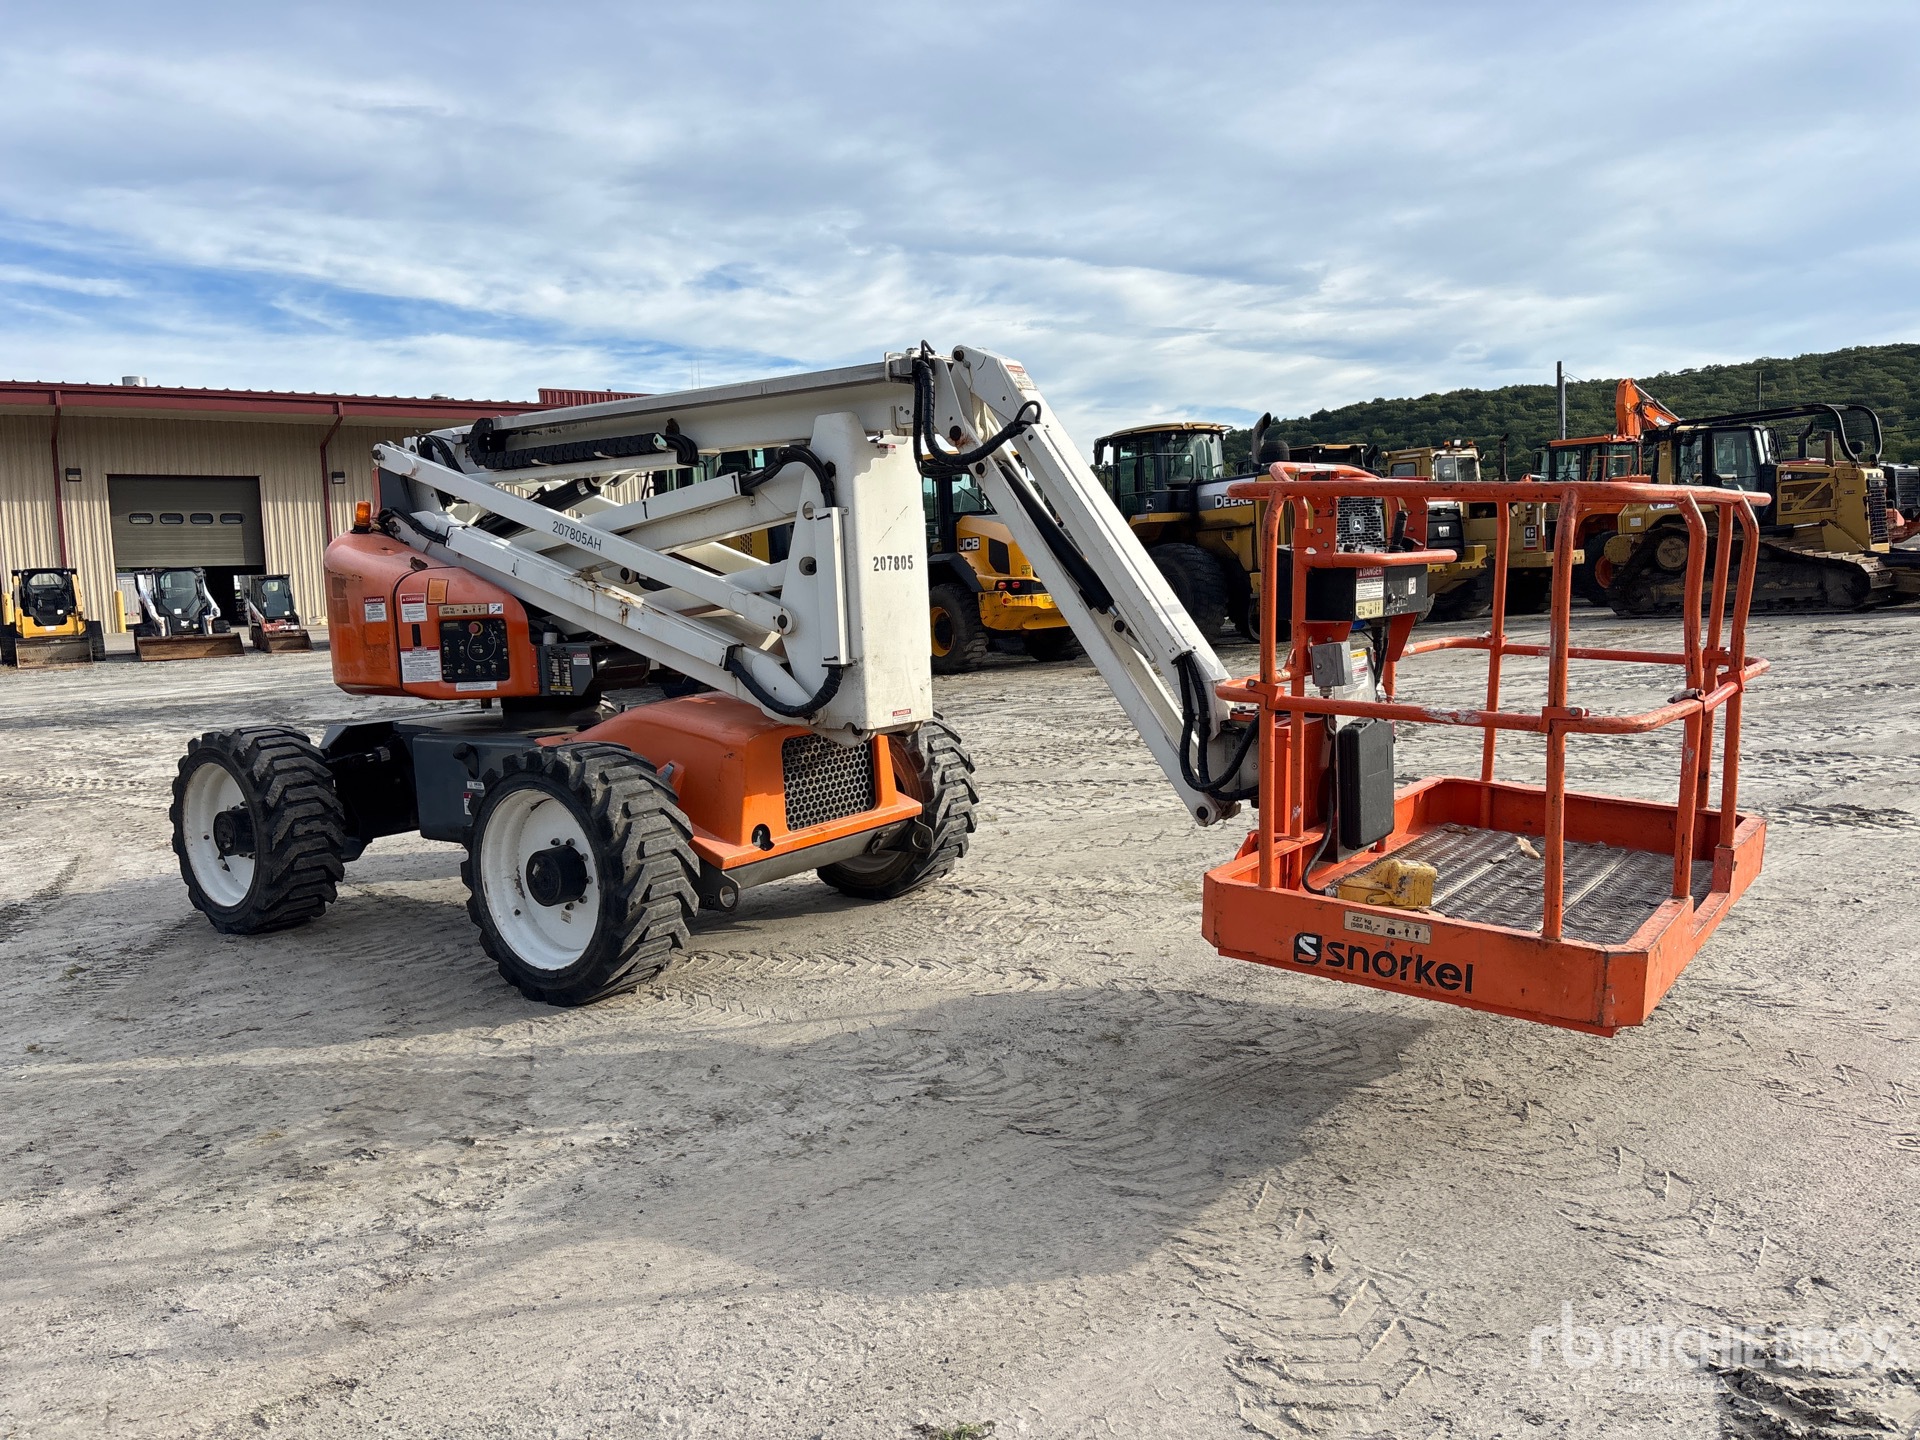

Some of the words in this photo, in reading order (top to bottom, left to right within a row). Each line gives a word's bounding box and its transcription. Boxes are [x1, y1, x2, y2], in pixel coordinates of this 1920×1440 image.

[552, 520, 602, 551] 207805AH
[959, 537, 980, 550] JCB
[873, 555, 914, 572] 207805
[1352, 915, 1363, 923] 227
[1364, 917, 1372, 925] kg
[1325, 941, 1473, 994] snorkel
